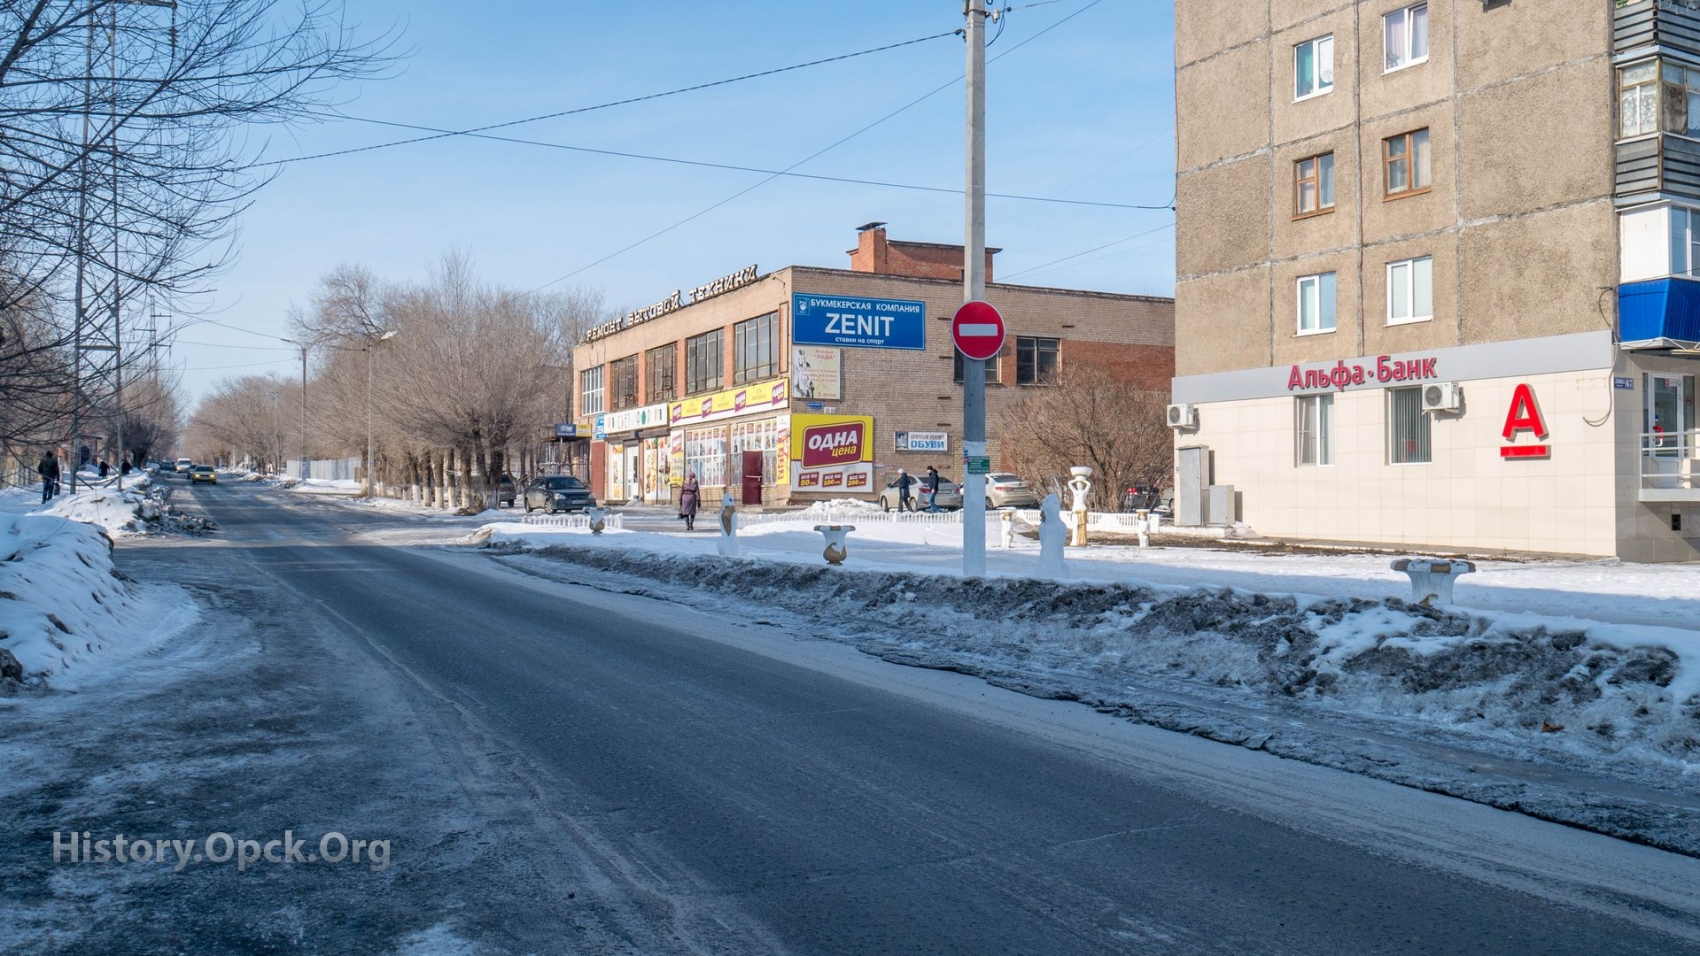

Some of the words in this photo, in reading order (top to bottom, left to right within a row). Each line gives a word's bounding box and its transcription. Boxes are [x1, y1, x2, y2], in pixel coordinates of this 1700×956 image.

[586, 317, 624, 341] РЕМОНТ
[627, 289, 681, 327] БЫТОВОЙ
[689, 264, 758, 303] ТЕХНИКИ
[811, 299, 871, 310] БУКМЕКЕРСКАЯ
[876, 303, 920, 313] КОМПАНИЯ
[825, 313, 894, 336] ZENIT
[808, 430, 858, 451] ОДНА
[910, 440, 945, 448] ОБУВИ
[831, 445, 857, 457] цена
